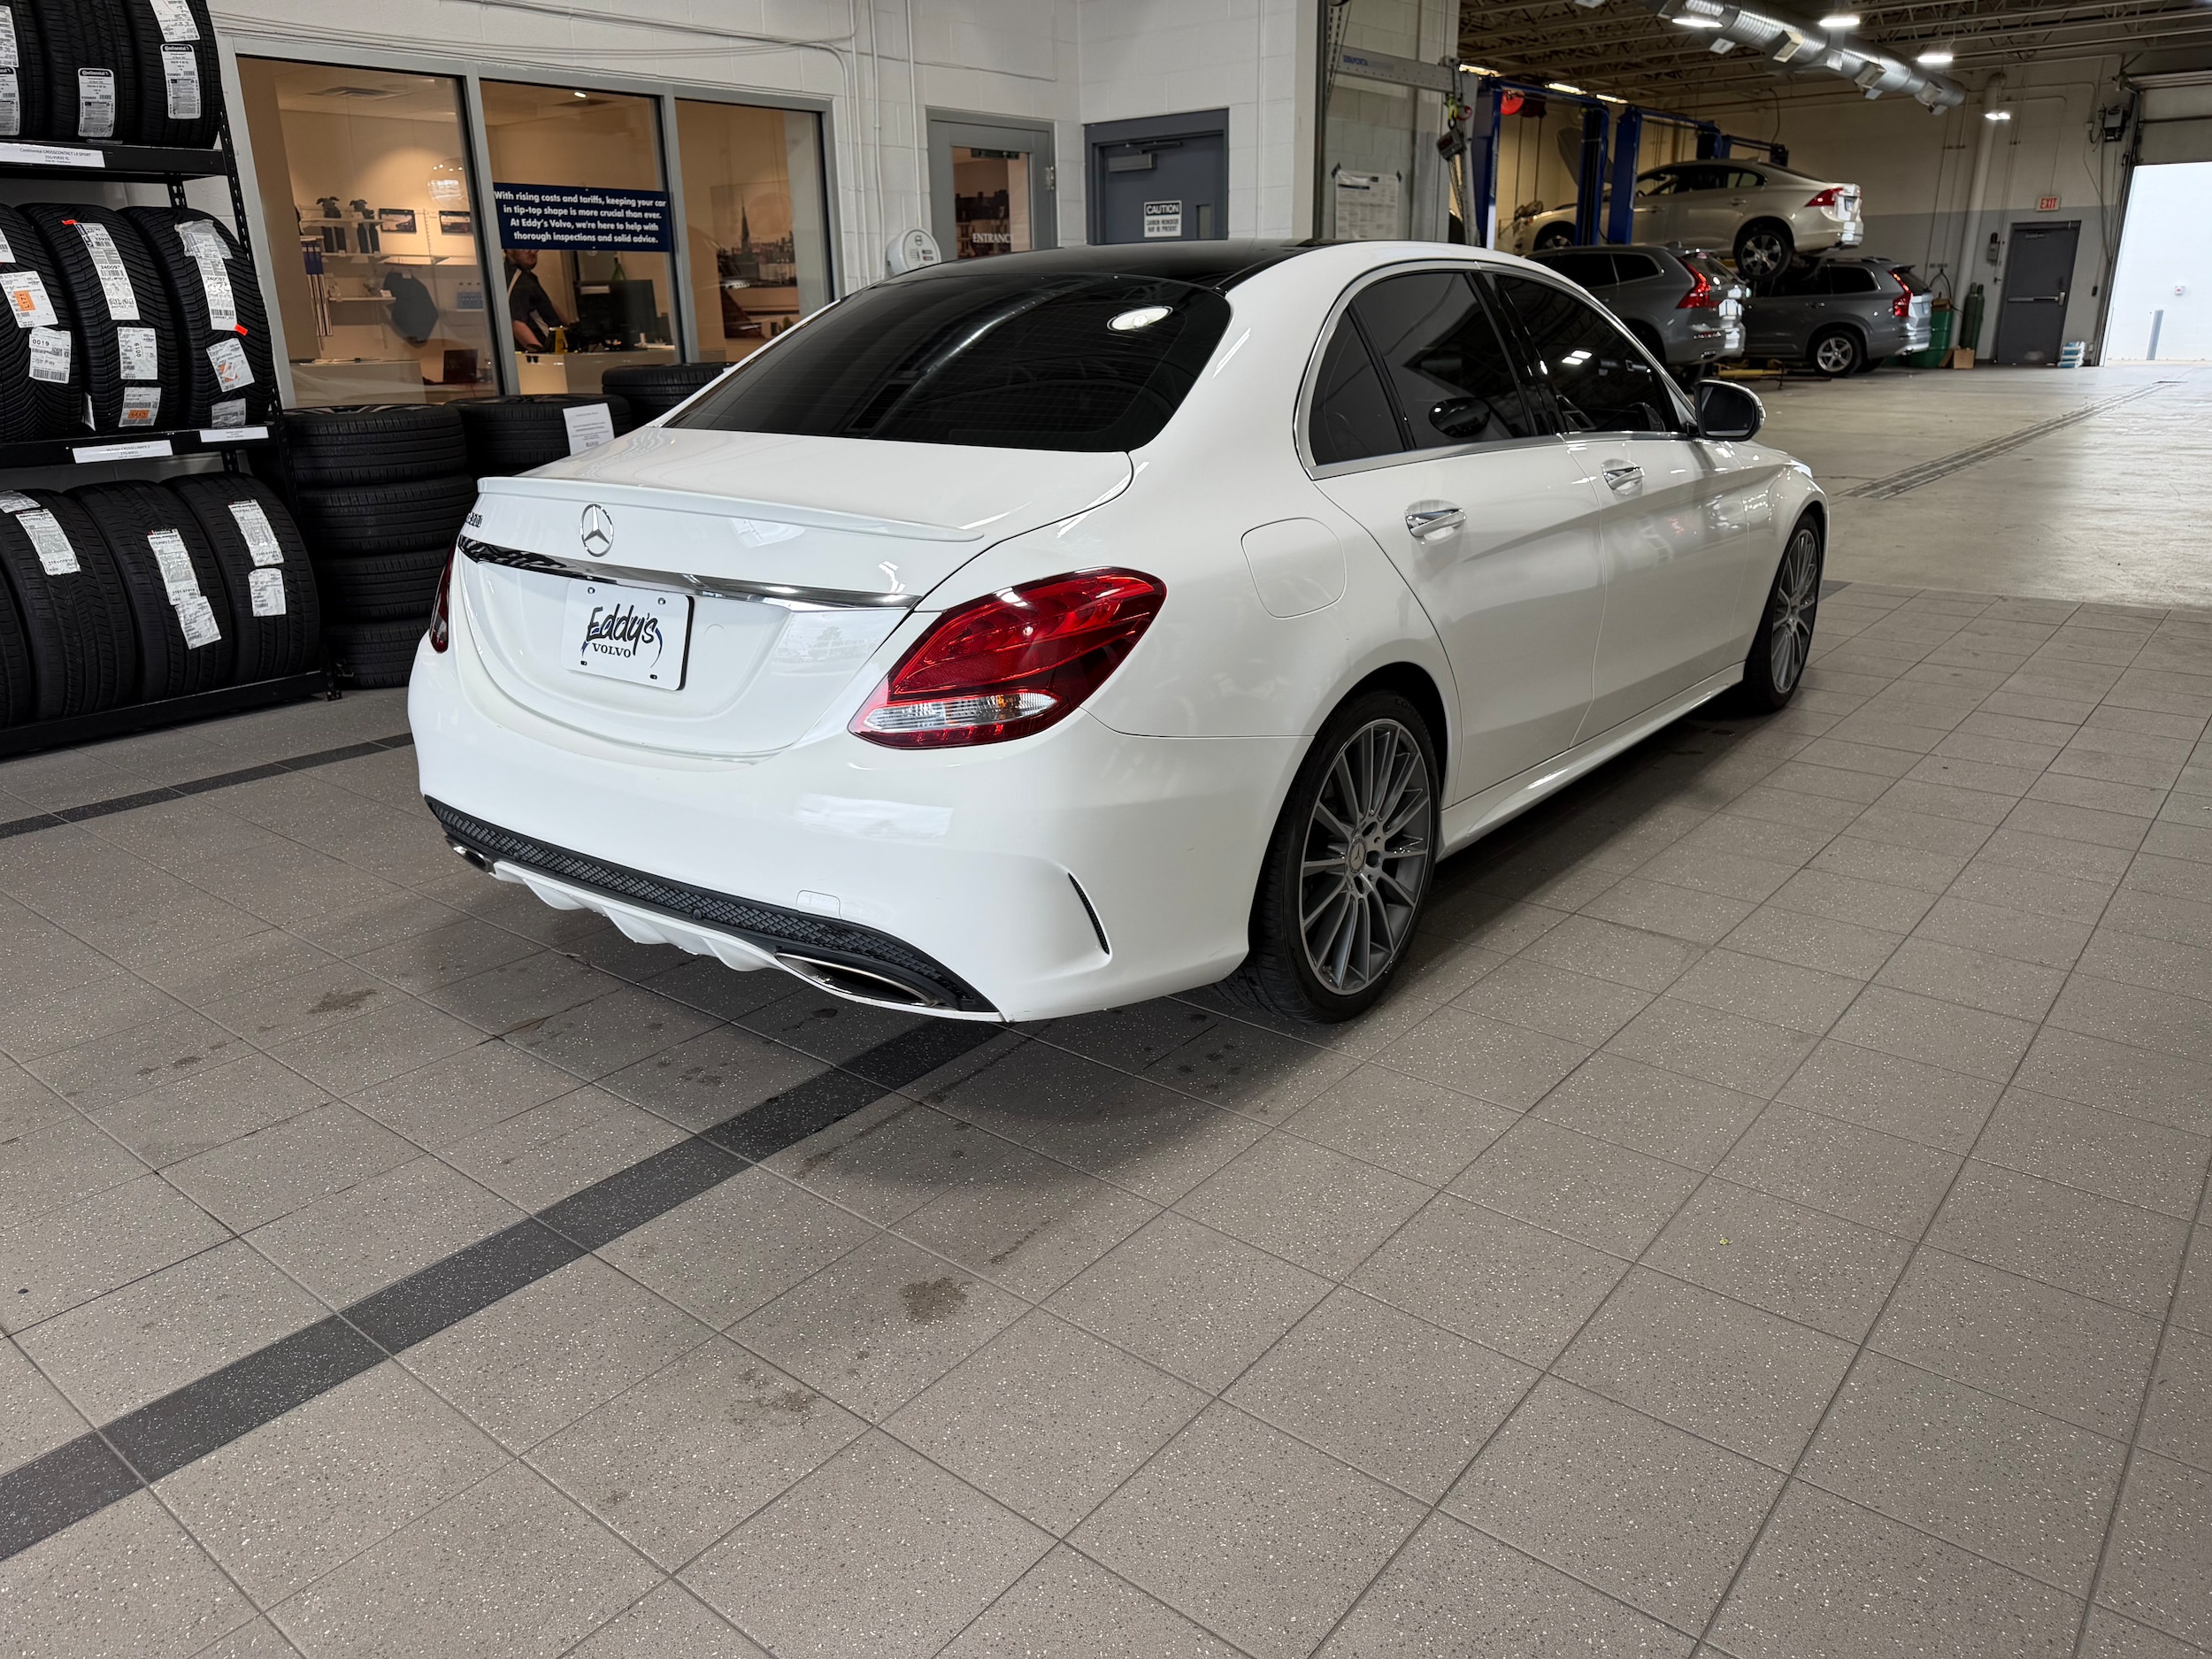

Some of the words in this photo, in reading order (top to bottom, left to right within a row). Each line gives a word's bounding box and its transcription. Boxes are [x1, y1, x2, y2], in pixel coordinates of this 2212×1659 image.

[494, 191, 514, 201] With
[516, 192, 540, 203] rising
[580, 196, 604, 204] tariffs,
[606, 196, 636, 207] keeping
[2039, 197, 2058, 210] EXIT
[503, 204, 512, 213] in
[513, 205, 542, 216] tip-top
[543, 206, 568, 217] shape
[1147, 204, 1179, 215] CAUTION
[511, 218, 519, 227] At
[521, 219, 549, 229] Eddy's
[549, 219, 574, 229] Volvo,
[575, 220, 595, 229] we're
[597, 220, 615, 229] here
[626, 222, 641, 232] help
[514, 231, 551, 242] thorough
[553, 232, 596, 242] inspections
[614, 234, 632, 242] solid
[633, 234, 658, 243] advice.
[32, 338, 50, 347] 0019
[586, 603, 659, 656] Eddy's
[591, 642, 631, 658] VOLVO
